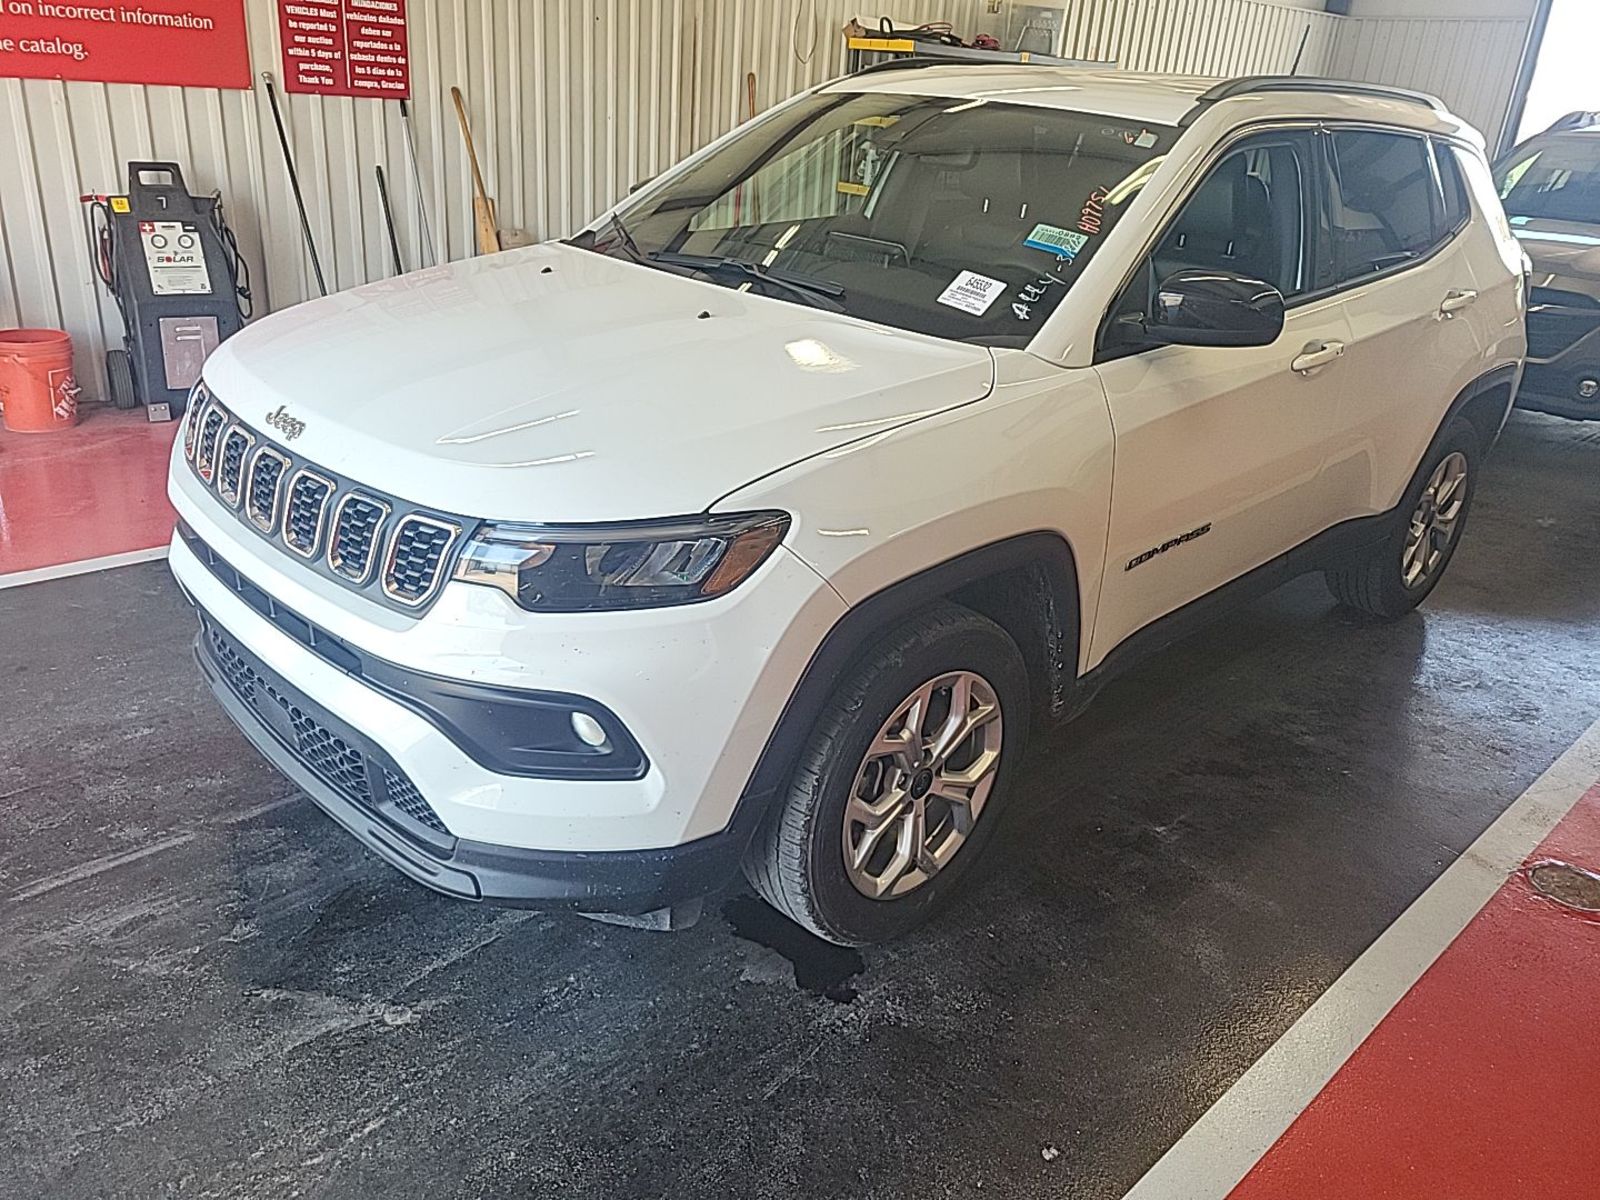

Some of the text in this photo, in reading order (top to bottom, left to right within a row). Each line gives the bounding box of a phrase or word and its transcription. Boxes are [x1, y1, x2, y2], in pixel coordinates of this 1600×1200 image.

[8, 1, 33, 15] on
[38, 0, 116, 22] incorrect
[120, 6, 214, 30] information
[285, 5, 318, 16] VEHICLES
[289, 19, 336, 32] be reported to
[294, 35, 333, 45] our auction
[19, 37, 89, 60] catalog.
[288, 48, 341, 59] within 5 days of
[398, 56, 406, 64] de
[355, 65, 365, 74] los
[366, 66, 371, 74] 5
[298, 75, 333, 85] Thank You
[265, 405, 306, 441] Jeep
[1124, 522, 1212, 572] COMPASS
